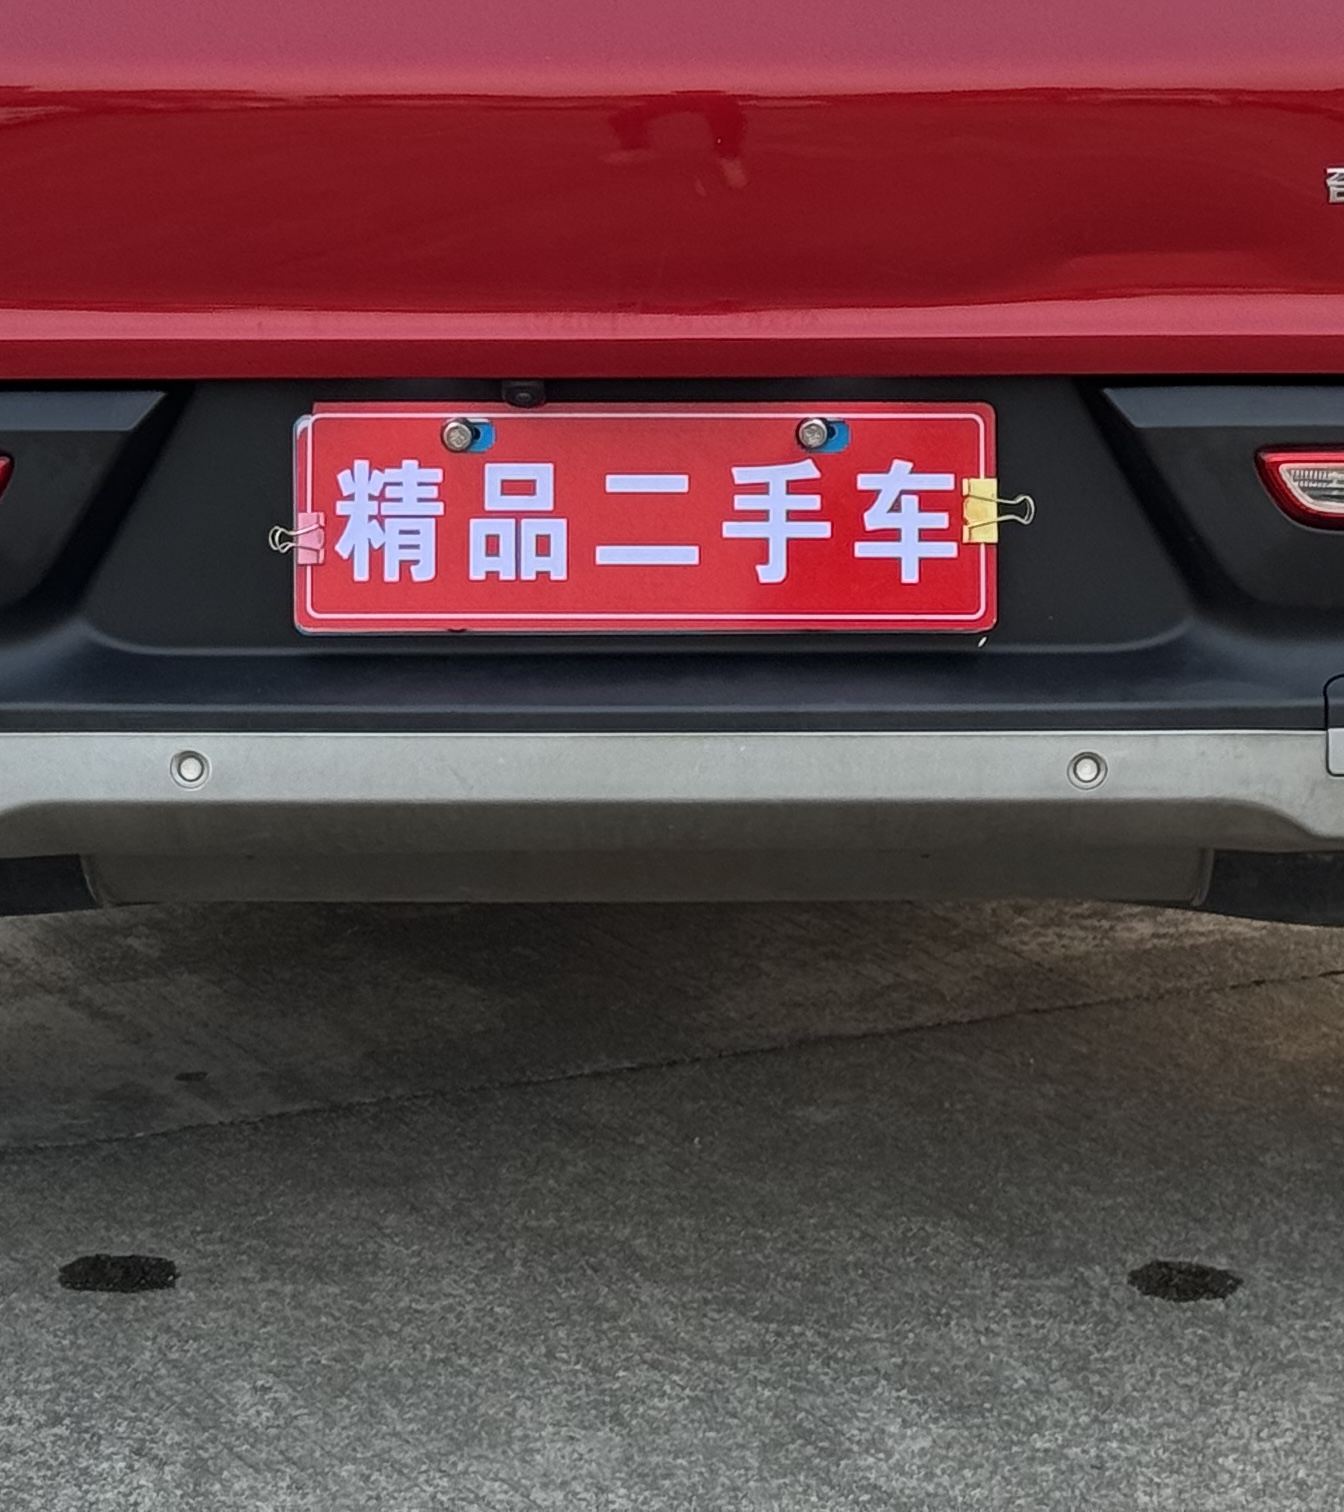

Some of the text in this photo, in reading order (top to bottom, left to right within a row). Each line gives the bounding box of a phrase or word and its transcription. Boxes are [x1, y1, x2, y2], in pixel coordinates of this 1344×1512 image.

[335, 458, 959, 585] 精品二手车
